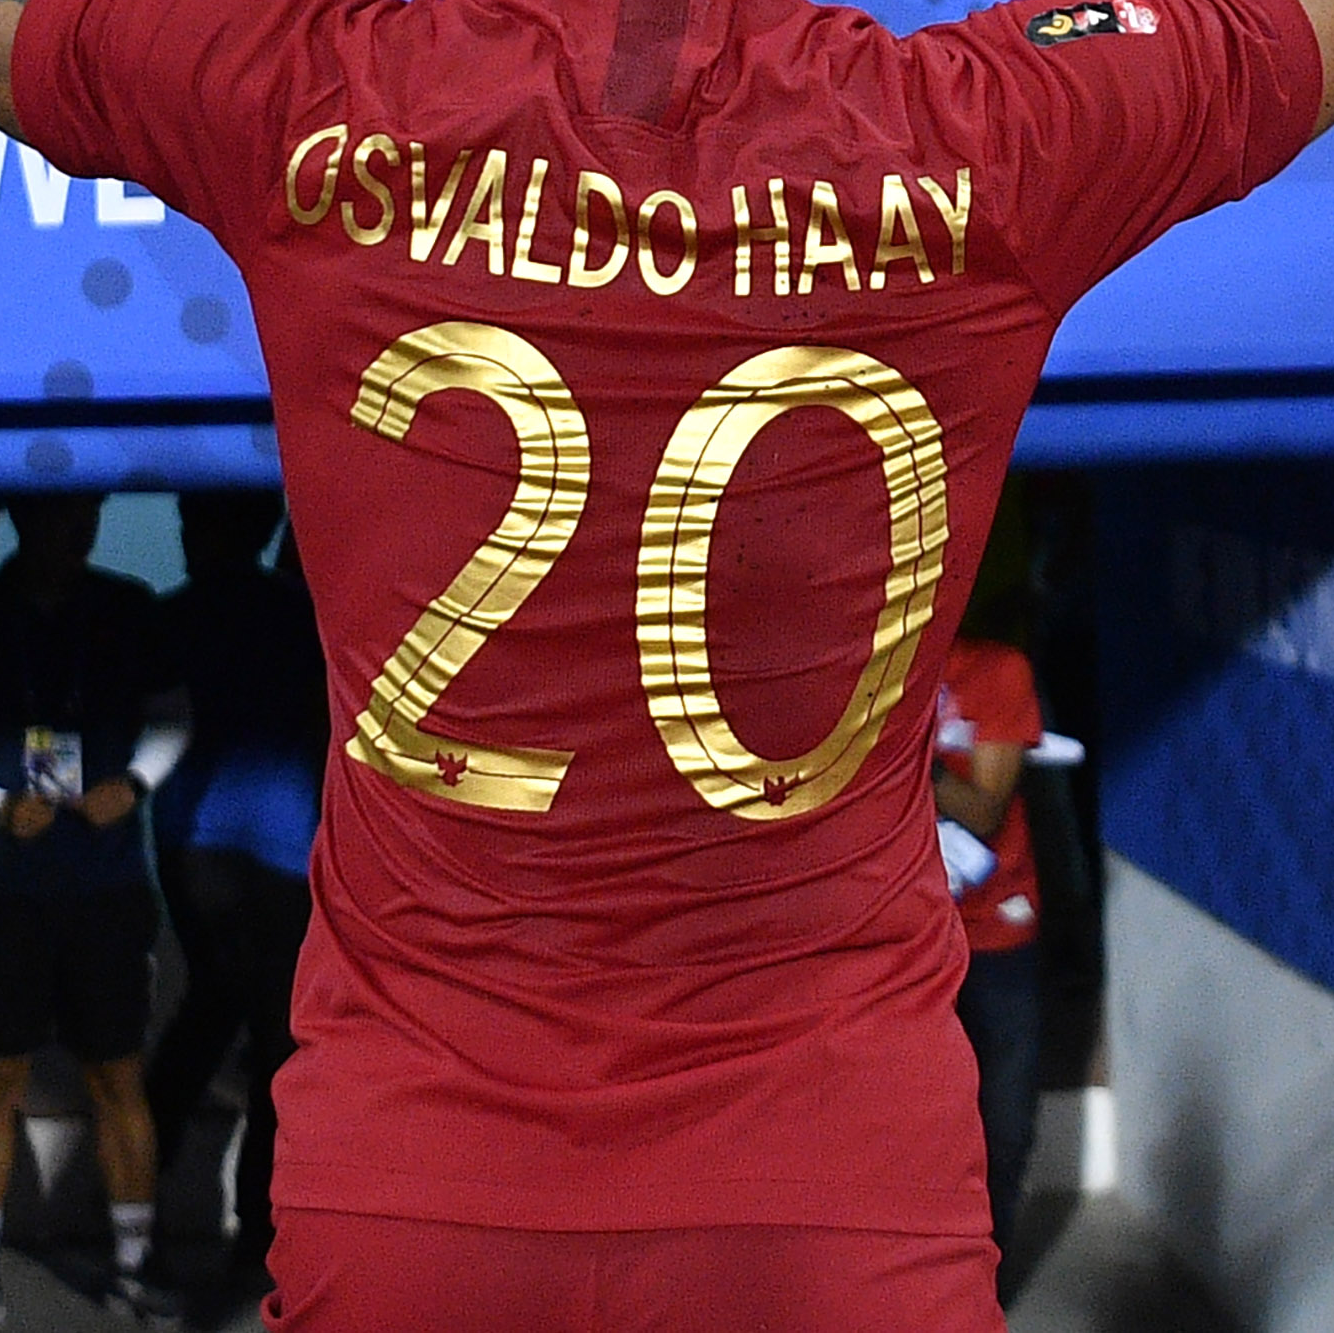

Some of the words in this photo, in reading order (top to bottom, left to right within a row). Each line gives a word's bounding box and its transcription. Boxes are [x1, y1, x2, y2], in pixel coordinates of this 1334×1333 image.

[284, 123, 698, 296] OSVALDO
[732, 166, 974, 296] HAAY
[347, 320, 949, 821] 20
